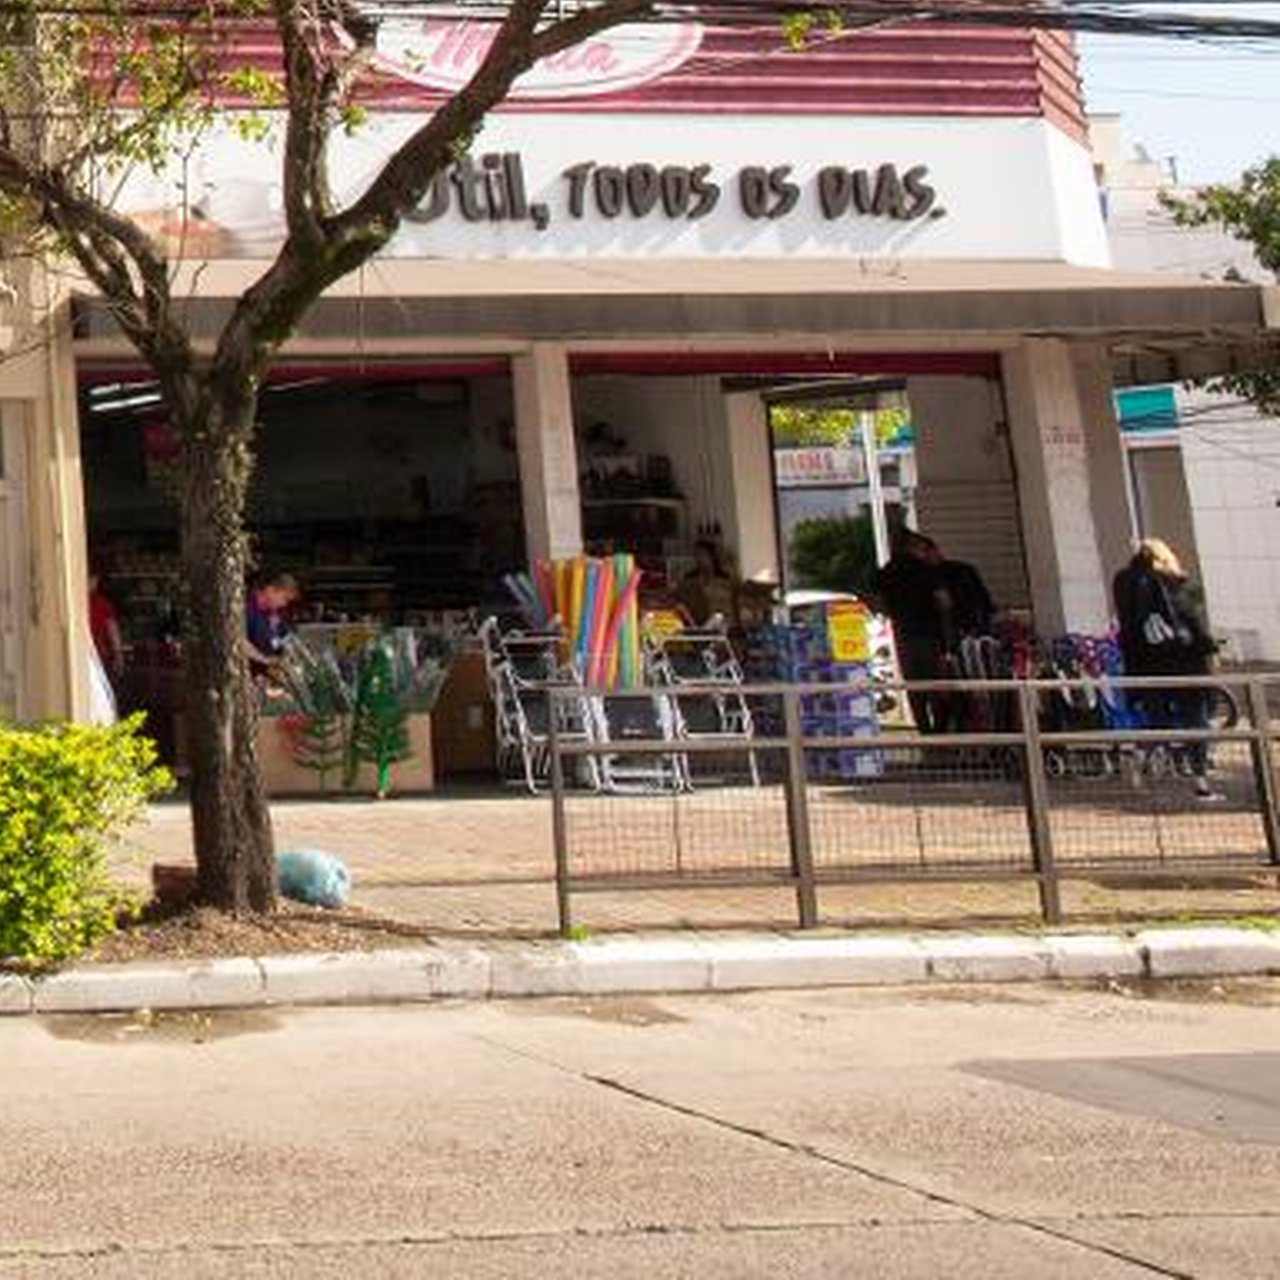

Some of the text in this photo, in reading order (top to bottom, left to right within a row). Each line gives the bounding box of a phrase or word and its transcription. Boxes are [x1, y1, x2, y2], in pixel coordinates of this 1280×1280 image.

[561, 161, 721, 219] TODOS
[740, 165, 800, 219] OS
[817, 163, 946, 219] DIAS.
